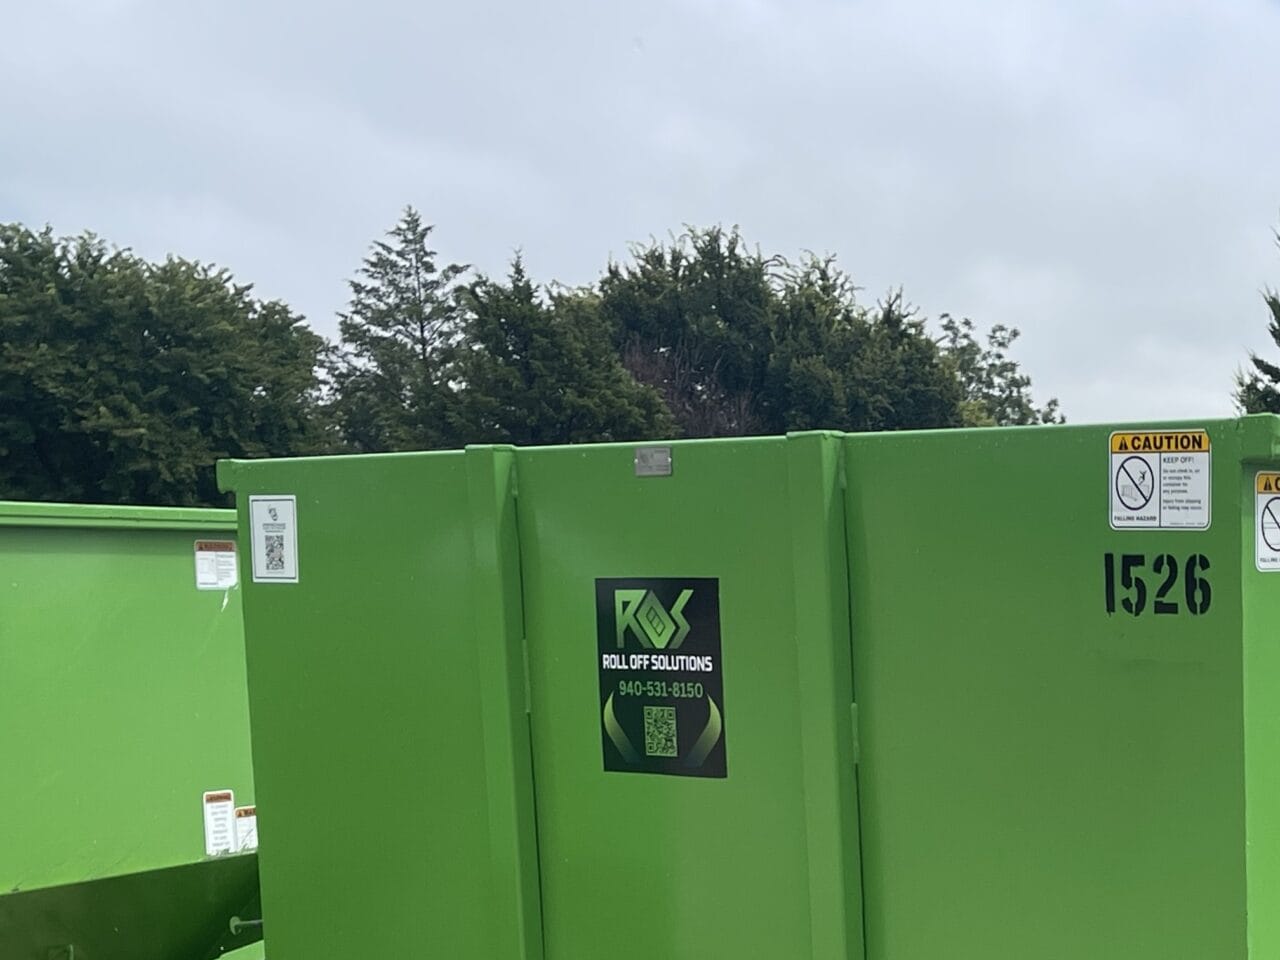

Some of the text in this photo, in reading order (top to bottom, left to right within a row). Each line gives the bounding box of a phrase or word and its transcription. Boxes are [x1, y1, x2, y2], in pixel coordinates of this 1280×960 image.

[1131, 434, 1203, 450] CAUTION
[1163, 456, 1179, 464] KEEP
[1104, 553, 1212, 617] 1526
[602, 654, 713, 672] ROLL OFF SOLUTIONS
[619, 680, 704, 698] 940-531-8150
